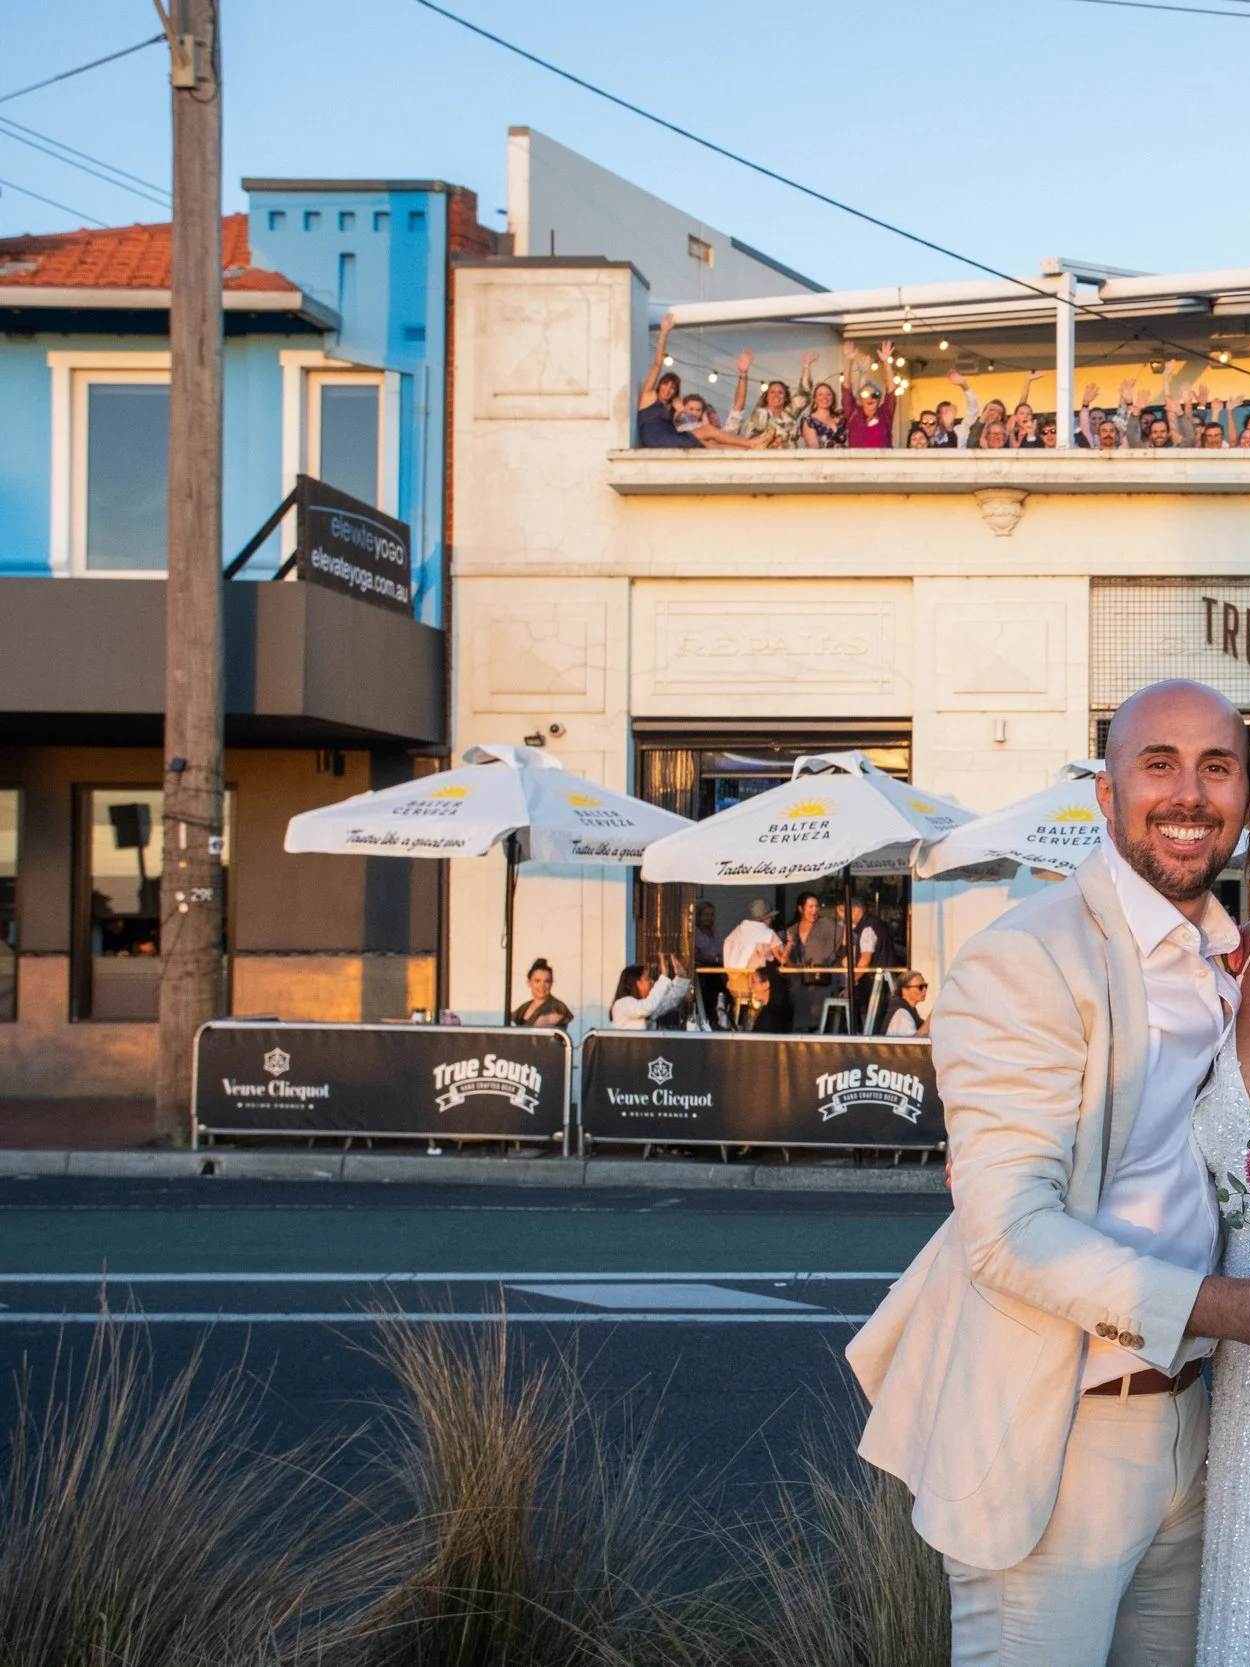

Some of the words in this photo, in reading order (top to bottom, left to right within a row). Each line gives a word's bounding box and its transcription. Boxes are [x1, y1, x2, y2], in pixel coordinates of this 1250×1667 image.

[311, 546, 408, 603] elevateyoga.com.au
[769, 820, 830, 833] BALTER
[1036, 826, 1100, 836] BALTER
[758, 831, 831, 844] CERVEZA
[1026, 834, 1102, 846] CERVEZA
[784, 861, 825, 879] great
[433, 1058, 480, 1091] True
[482, 1053, 542, 1094] South
[816, 1068, 862, 1099] True
[865, 1064, 925, 1102] South
[222, 1078, 266, 1097] Veuve
[267, 1079, 330, 1101] Clicquot
[606, 1088, 649, 1105] Veuve
[652, 1088, 713, 1110] Clicquot
